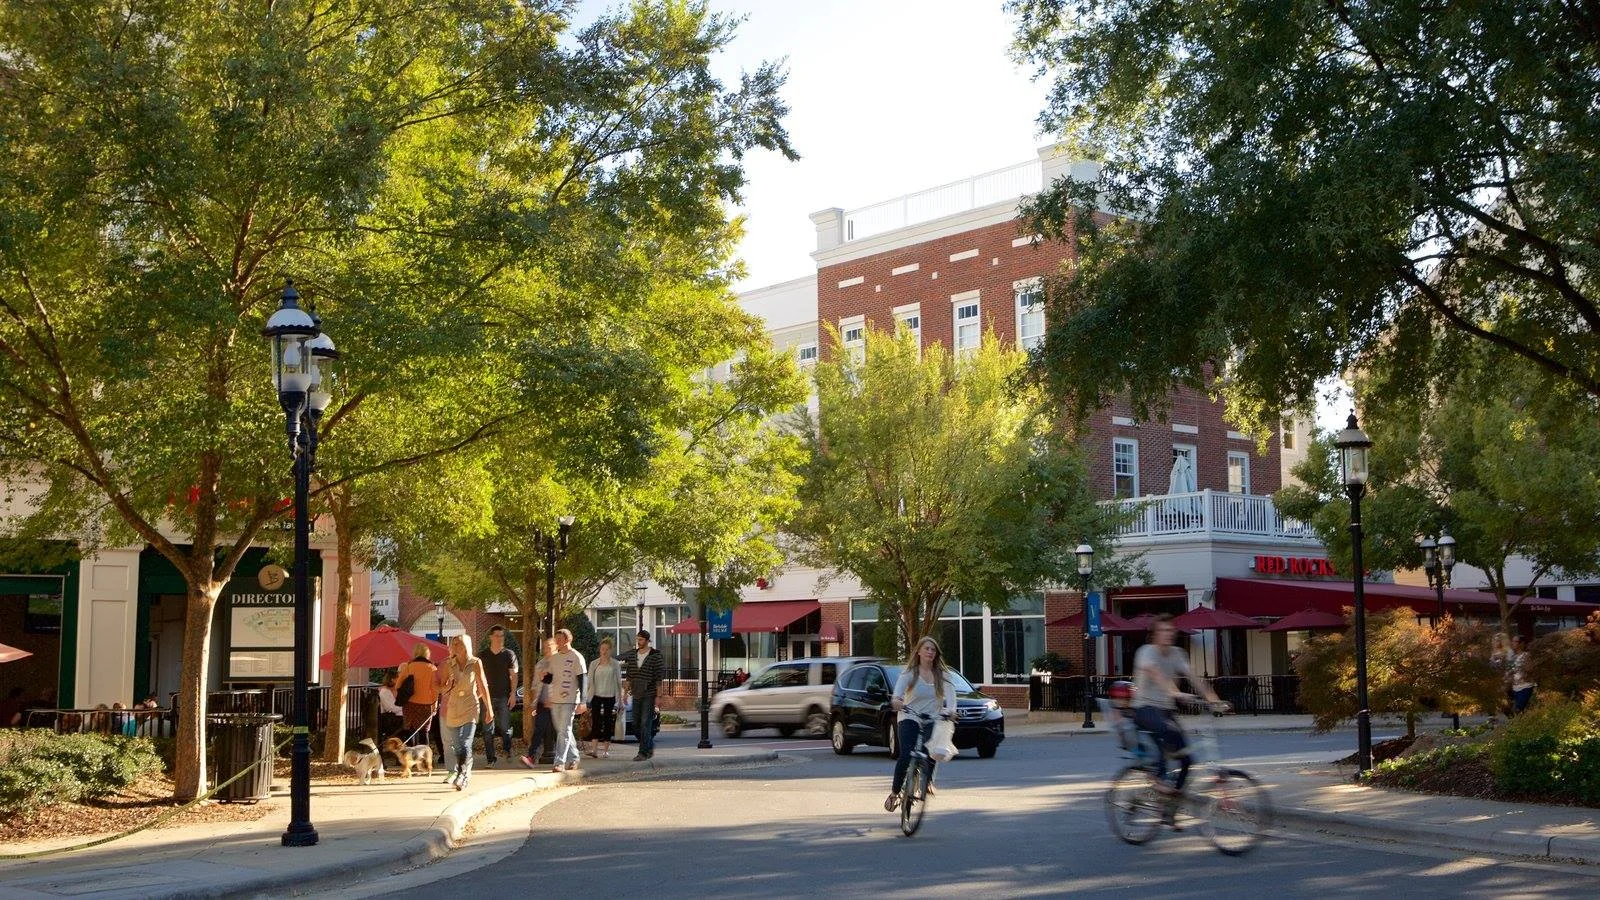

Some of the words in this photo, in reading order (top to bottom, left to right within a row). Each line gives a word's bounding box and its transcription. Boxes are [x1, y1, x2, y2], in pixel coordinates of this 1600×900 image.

[1254, 555, 1286, 574] RED
[1287, 557, 1336, 576] ROCKS
[231, 593, 296, 604] DIRECTO
